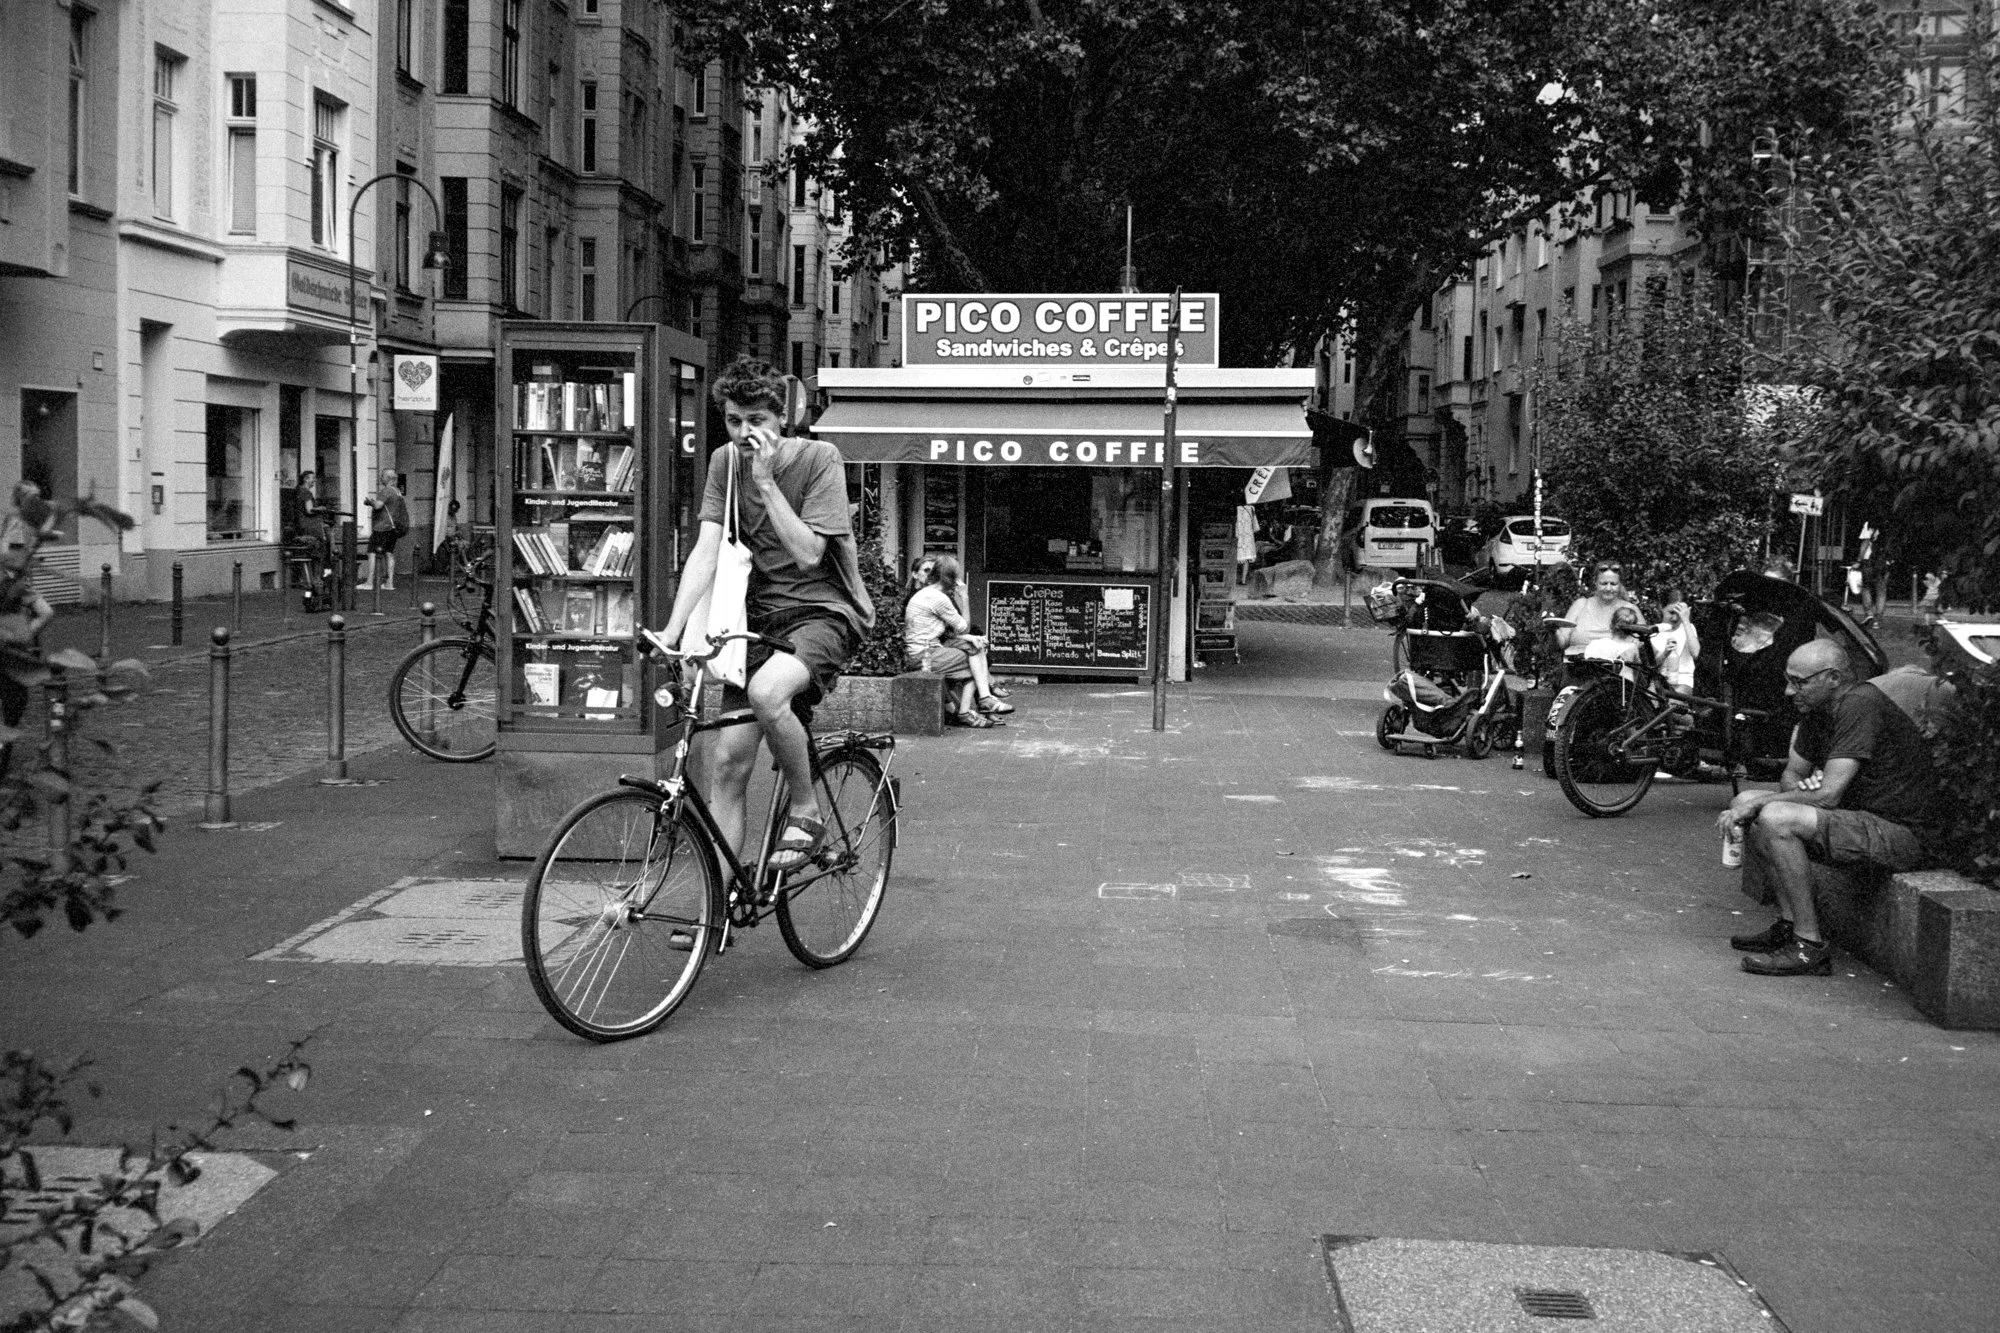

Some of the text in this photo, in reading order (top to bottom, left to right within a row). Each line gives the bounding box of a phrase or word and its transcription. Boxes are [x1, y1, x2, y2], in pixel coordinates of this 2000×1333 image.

[915, 301, 1206, 333] PICO COFFEE
[936, 337, 1184, 361] Sandwiches & Crêpes
[930, 439, 1022, 462] PICO
